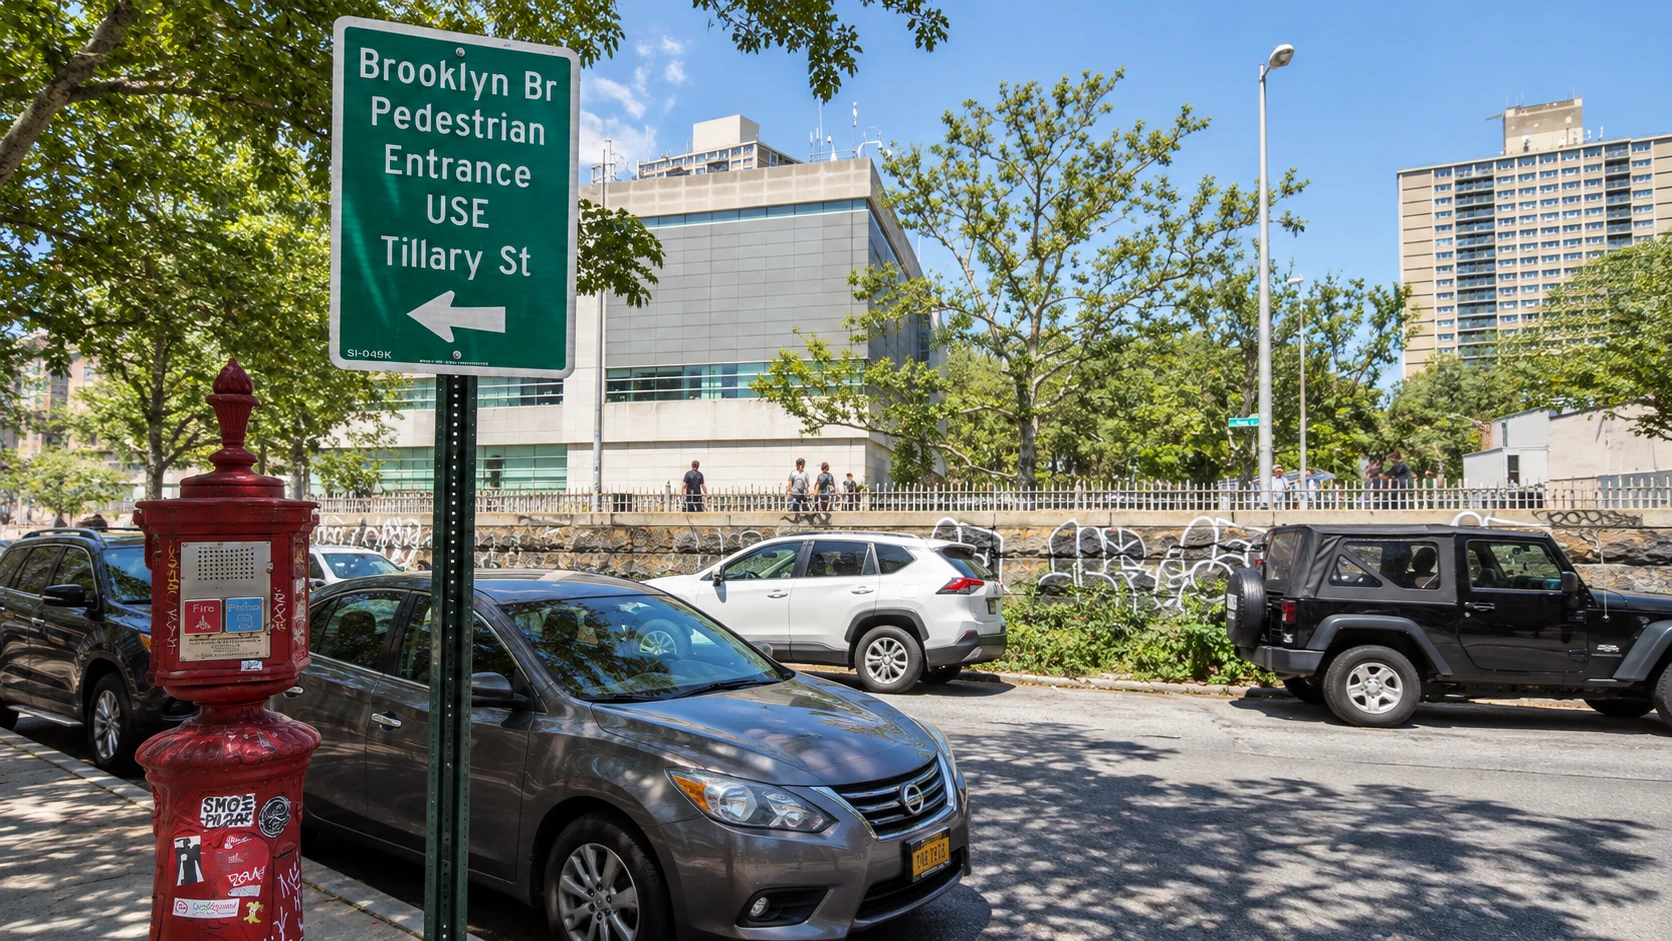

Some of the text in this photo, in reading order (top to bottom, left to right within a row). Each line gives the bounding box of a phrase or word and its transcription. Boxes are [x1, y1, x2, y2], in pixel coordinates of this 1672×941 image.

[360, 47, 557, 102] Brooklyn Br
[371, 95, 545, 146] Pedestrian
[385, 144, 531, 188] Entrance
[427, 194, 489, 229] USE
[380, 235, 531, 281] Tillary St
[347, 348, 392, 359] SI-049K
